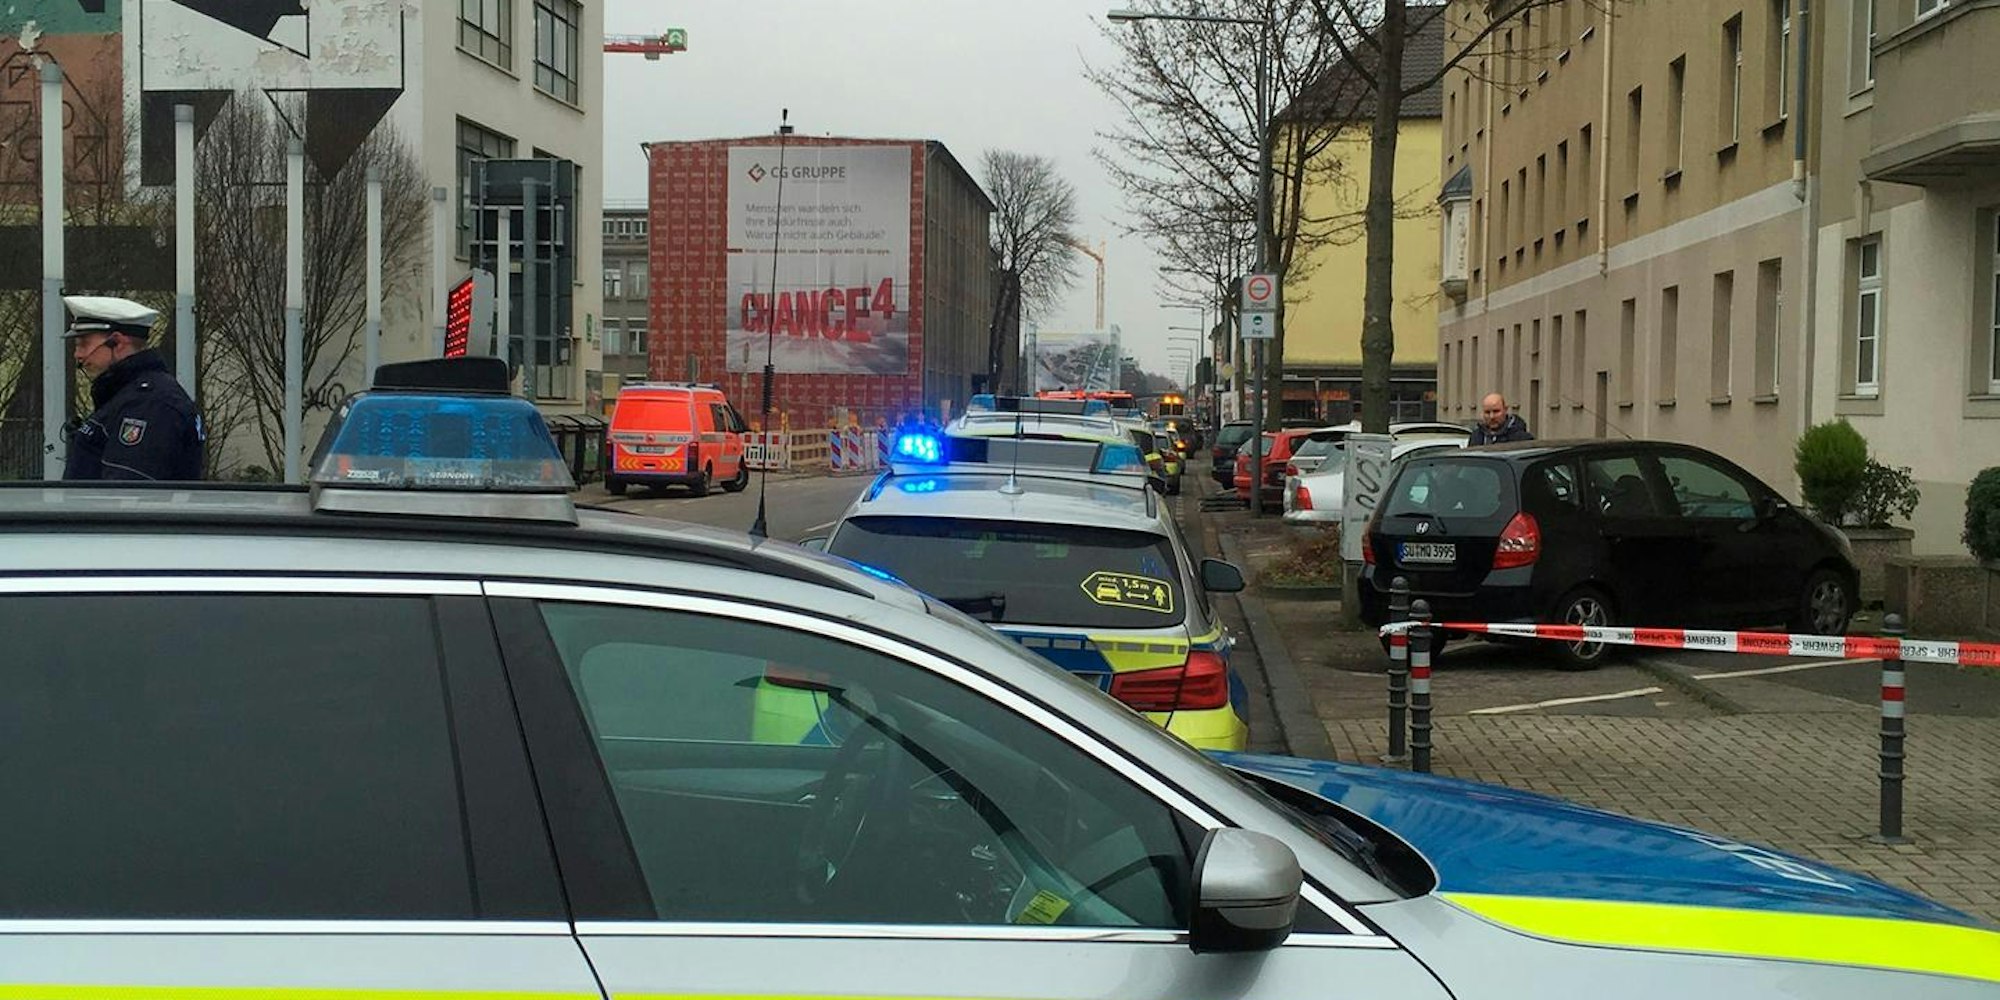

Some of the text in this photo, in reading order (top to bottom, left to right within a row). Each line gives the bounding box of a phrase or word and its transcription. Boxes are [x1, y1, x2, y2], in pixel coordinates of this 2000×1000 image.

[771, 166, 846, 179] CG GRUPPE
[1404, 545, 1415, 557] SU
[1433, 545, 1456, 559] 3995
[1674, 634, 1727, 647] FEUERWEHR
[1742, 637, 1793, 649] SPERRZONE
[1802, 639, 1858, 653] FEUERWEHR
